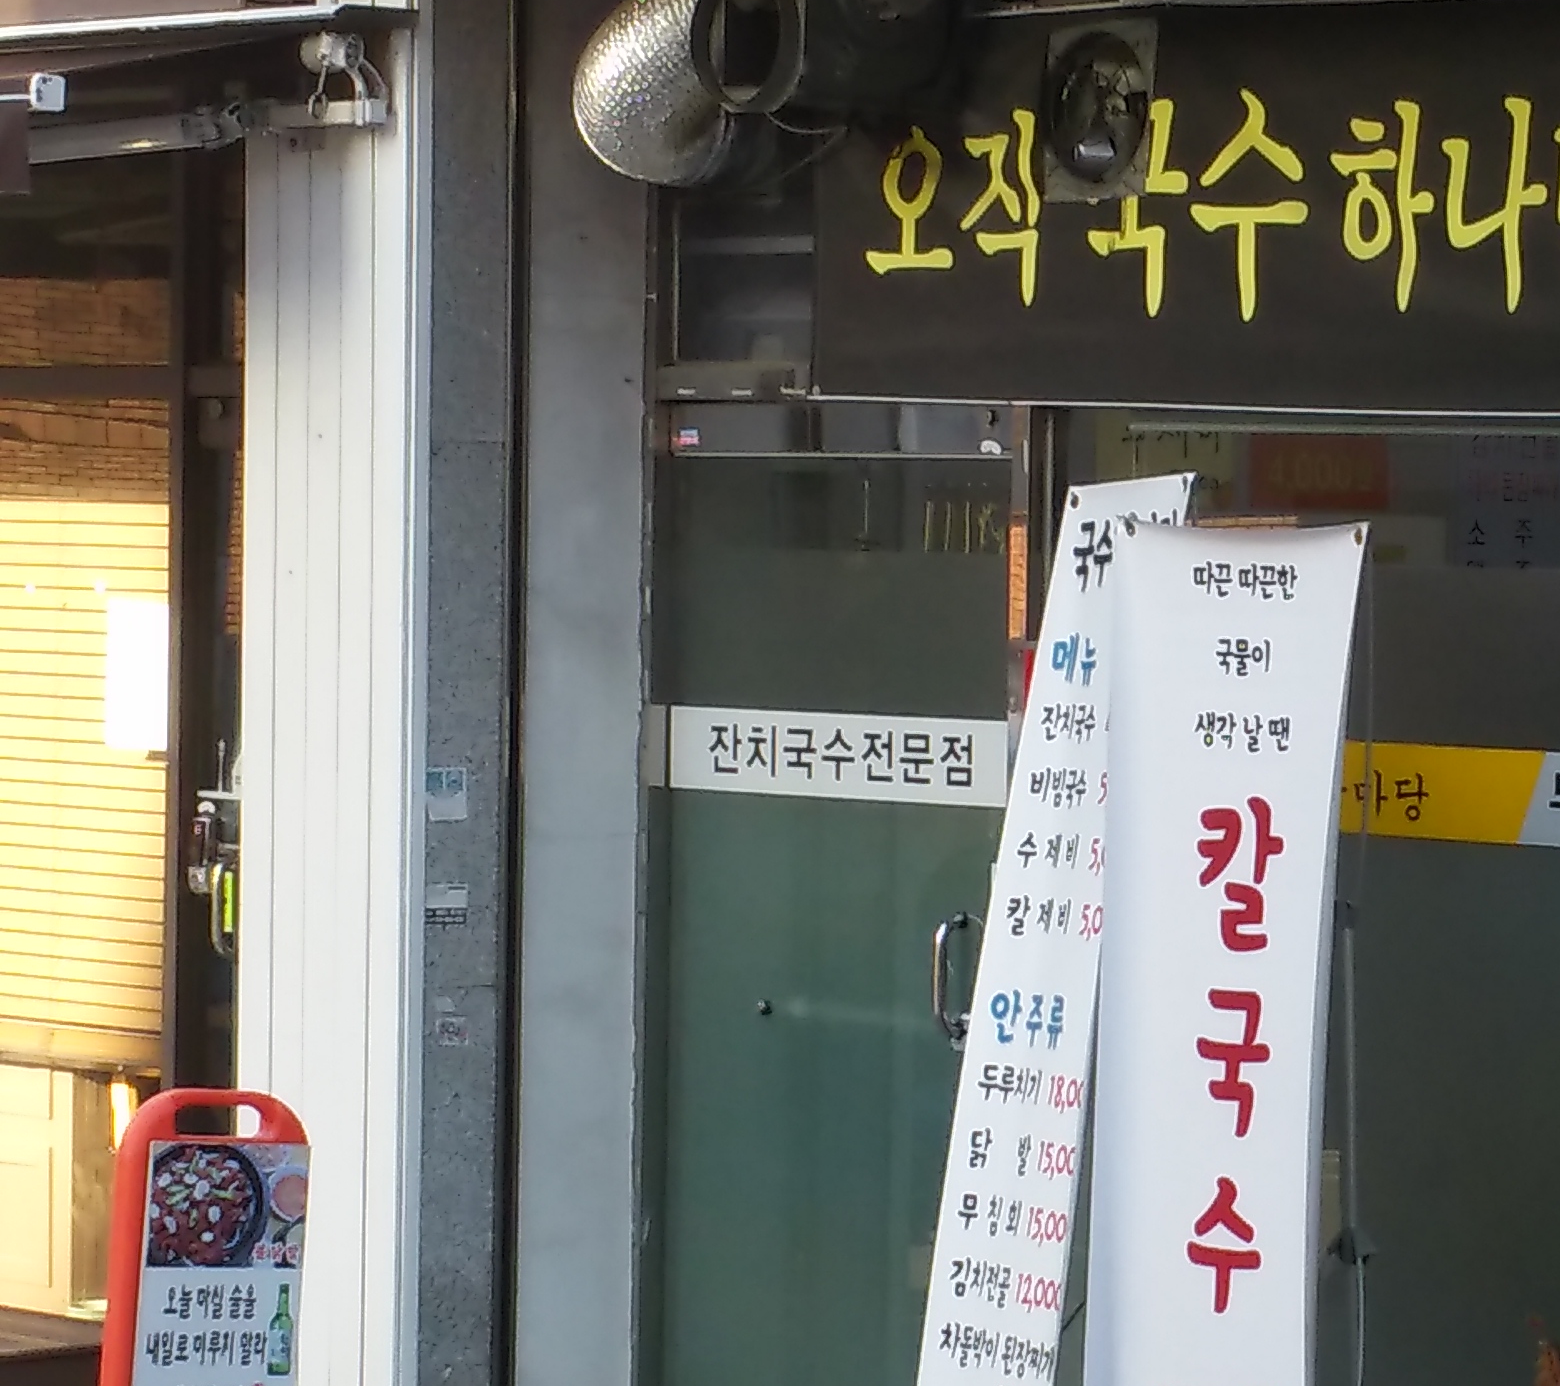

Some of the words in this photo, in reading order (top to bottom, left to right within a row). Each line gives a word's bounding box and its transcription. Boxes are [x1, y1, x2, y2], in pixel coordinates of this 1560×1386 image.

[864, 107, 1042, 310] 오직
[1050, 632, 1098, 687] 메뉴
[1215, 638, 1271, 677] 국물이
[1040, 702, 1097, 745] 잔치국수
[1194, 711, 1237, 750] 생각
[1268, 716, 1291, 753] 땐
[707, 724, 975, 788] 잔치국수전문점
[1029, 766, 1088, 811] 비빔국수
[1342, 769, 1430, 821] 마당
[989, 988, 1066, 1051] 안주류
[1187, 795, 1286, 1315] 칼국수
[977, 1063, 1043, 1106] 두루치기
